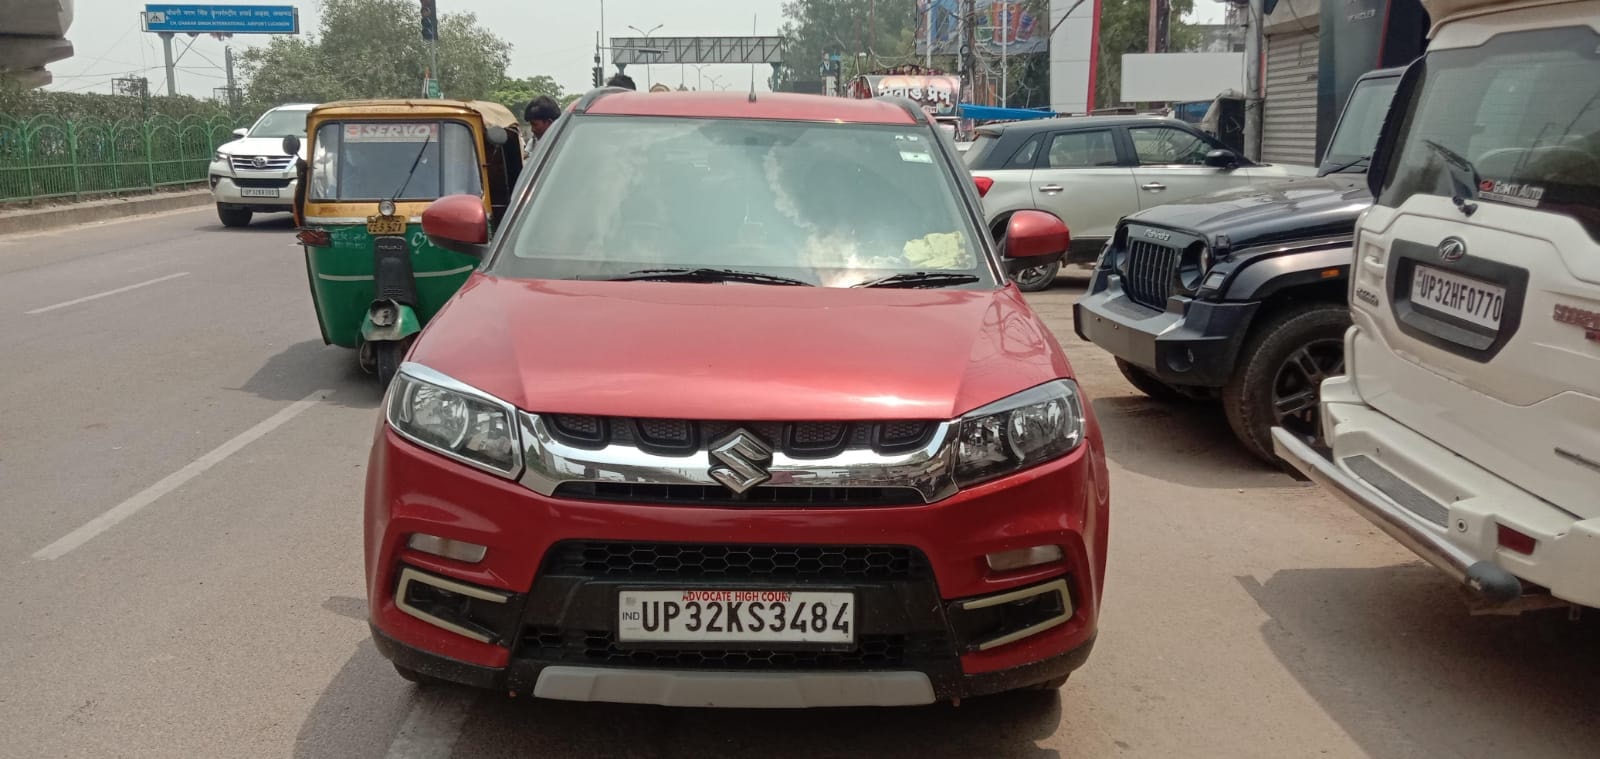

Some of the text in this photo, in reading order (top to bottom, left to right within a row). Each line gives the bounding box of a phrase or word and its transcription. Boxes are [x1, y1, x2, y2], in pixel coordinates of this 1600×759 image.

[361, 125, 431, 137] SERVO
[1518, 184, 1545, 200] AUTO
[1420, 273, 1503, 322] UP32HF0770
[682, 591, 732, 601] ADVOCATE
[735, 591, 759, 601] HIGH
[622, 600, 849, 634] IND UP32KS3484
